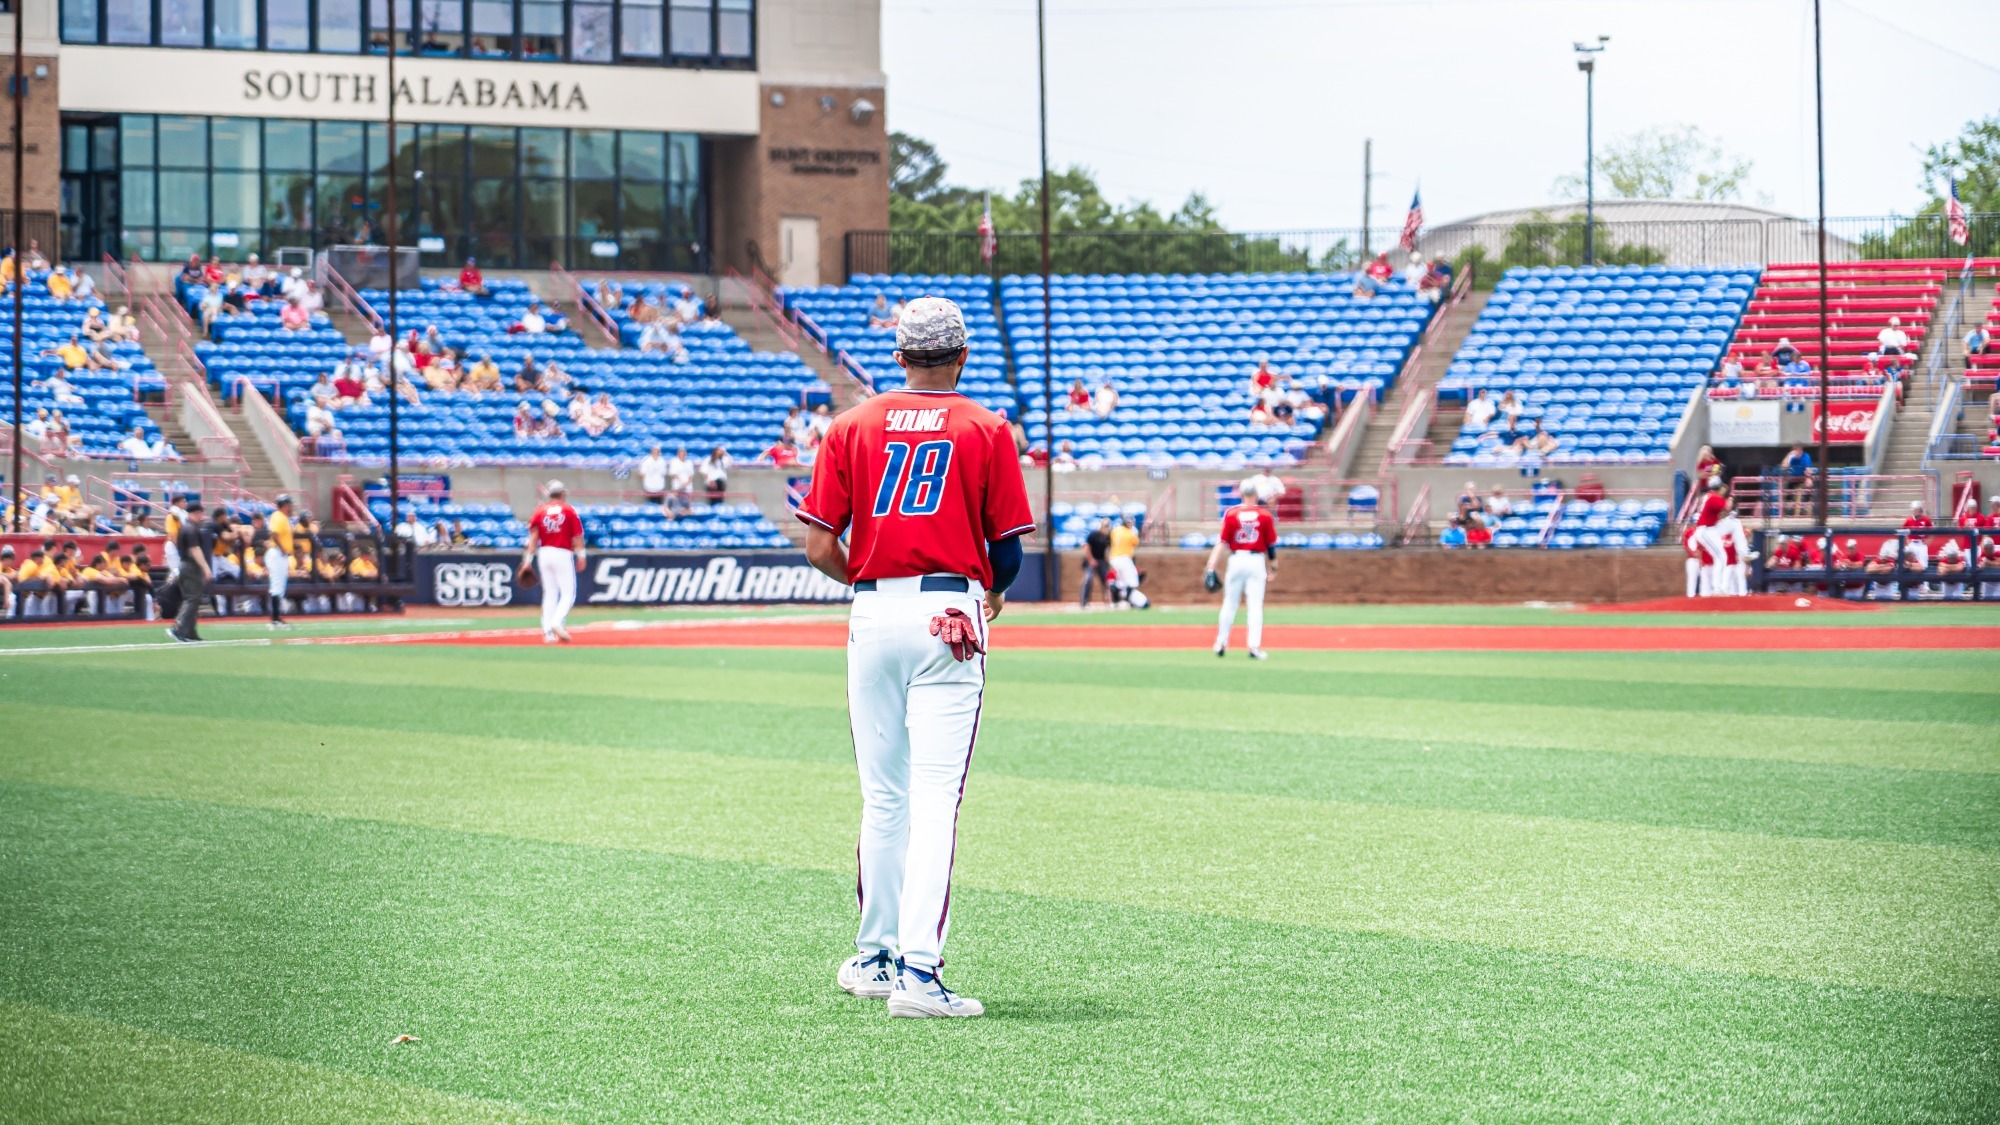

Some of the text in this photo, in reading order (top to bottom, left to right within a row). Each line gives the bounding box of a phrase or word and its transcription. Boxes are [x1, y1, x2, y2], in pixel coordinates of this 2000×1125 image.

[243, 70, 590, 111] SOUTH ALABAMA
[884, 408, 948, 431] YOUNG
[872, 440, 954, 517] 18
[434, 562, 513, 606] SBC
